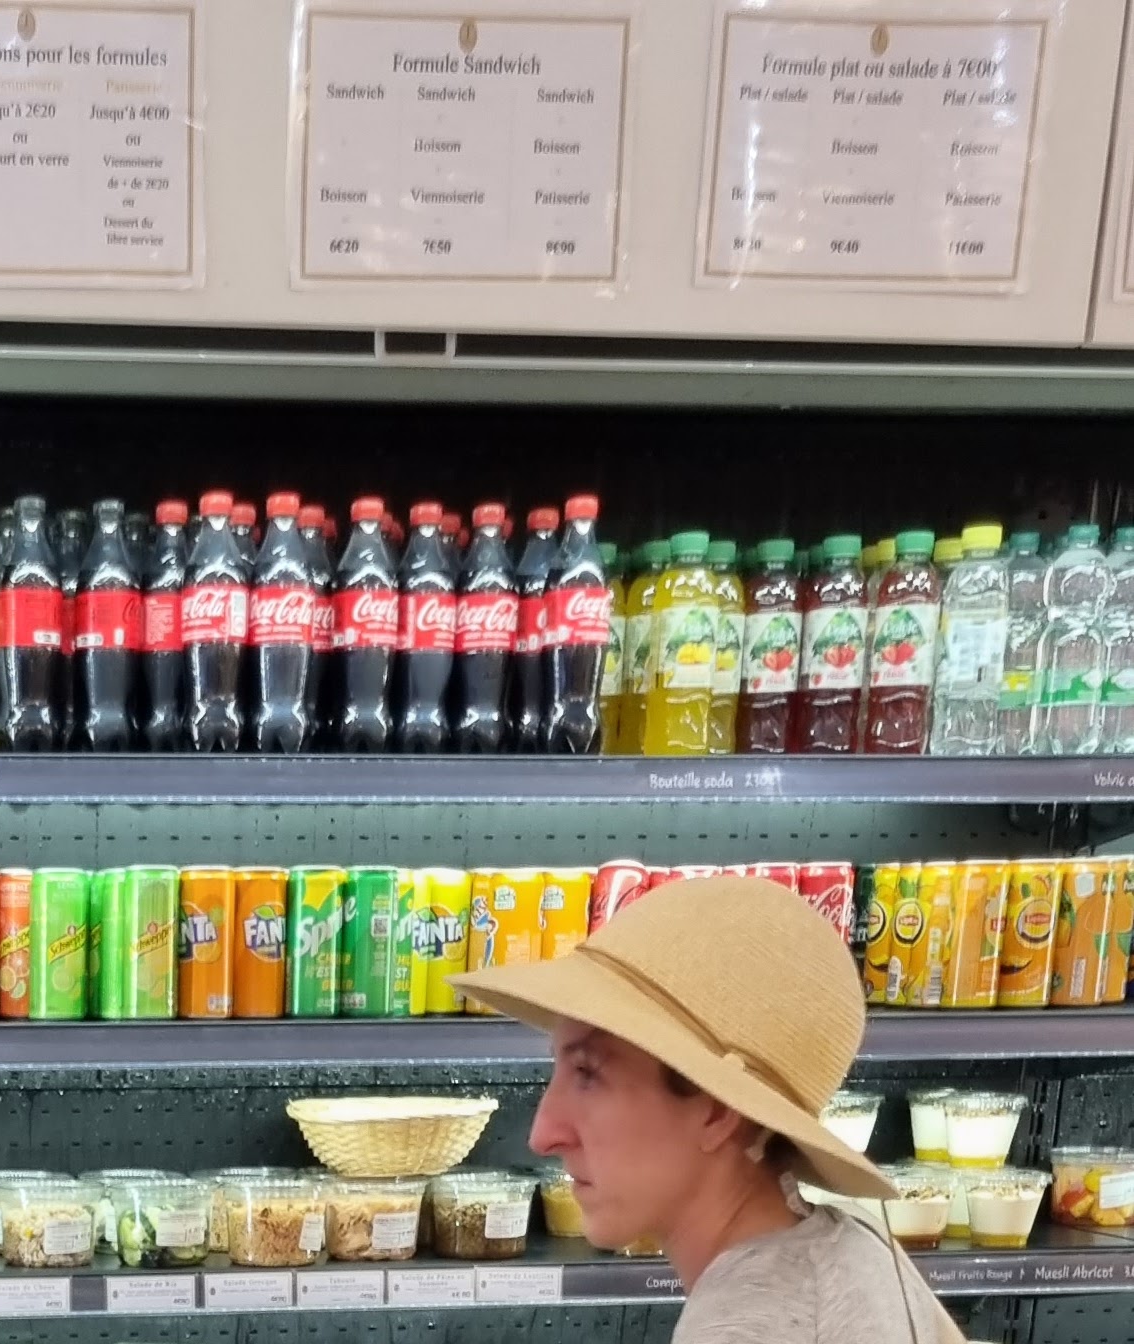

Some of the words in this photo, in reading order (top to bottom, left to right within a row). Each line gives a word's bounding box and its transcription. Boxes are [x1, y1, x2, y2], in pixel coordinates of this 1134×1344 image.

[26, 47, 64, 66] pour
[68, 45, 91, 66] les
[96, 46, 168, 68] formules
[392, 53, 459, 75] Formule
[463, 54, 541, 76] Sandwich
[762, 54, 827, 77] Formule
[829, 56, 860, 82] plat
[863, 61, 884, 79] ou
[888, 57, 939, 80] salade
[941, 58, 952, 79] à
[326, 83, 385, 101] Sandwich
[417, 85, 476, 103] Sandwich
[536, 87, 595, 105] Sandwich
[739, 84, 763, 101] Plat
[832, 88, 856, 105] Plat
[942, 89, 966, 106] Plat
[25, 103, 56, 119] 2€20
[89, 104, 136, 122] Jusqu'à
[138, 105, 171, 121] 4€00
[12, 131, 29, 145] ou
[125, 134, 142, 148] ou
[413, 138, 462, 154] Boisson
[533, 139, 580, 155] Boisson
[830, 140, 879, 157] Boisson
[19, 154, 35, 167] en
[37, 154, 70, 168] verre
[103, 153, 164, 169] Viennoiserie
[319, 187, 368, 204] Boisson
[410, 188, 485, 206] Viennoiserie
[822, 190, 895, 207] Viennoiserie
[329, 239, 360, 254] 6€20
[422, 239, 452, 255] 7€50
[649, 771, 700, 789] Bouteille
[704, 771, 734, 788] soda
[1094, 771, 1125, 788] Volvic
[412, 915, 464, 947] FANTA
[1034, 1264, 1069, 1281] Muesli
[1071, 1264, 1114, 1279] Abricot
